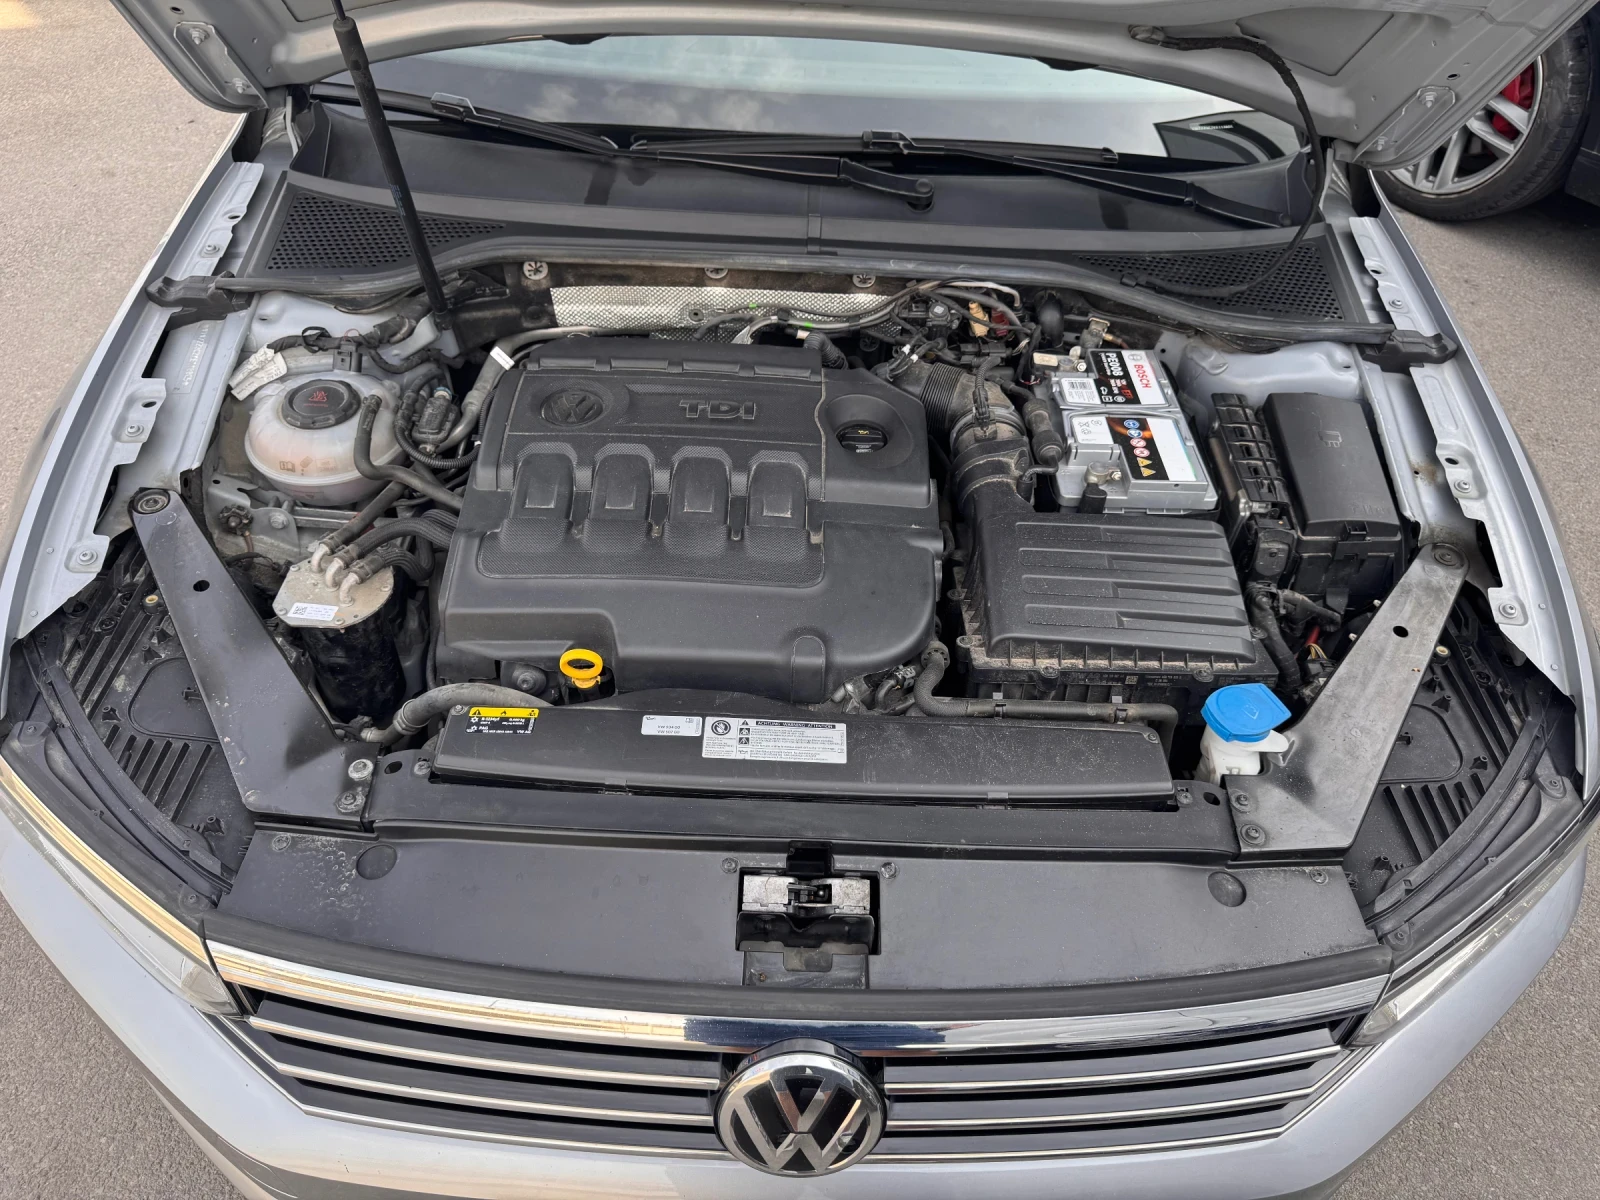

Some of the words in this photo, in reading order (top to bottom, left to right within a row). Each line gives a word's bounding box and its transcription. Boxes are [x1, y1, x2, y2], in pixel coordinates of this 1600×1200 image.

[1105, 352, 1124, 376] PE008
[1134, 364, 1152, 388] BOSCH
[679, 399, 757, 420] TDI
